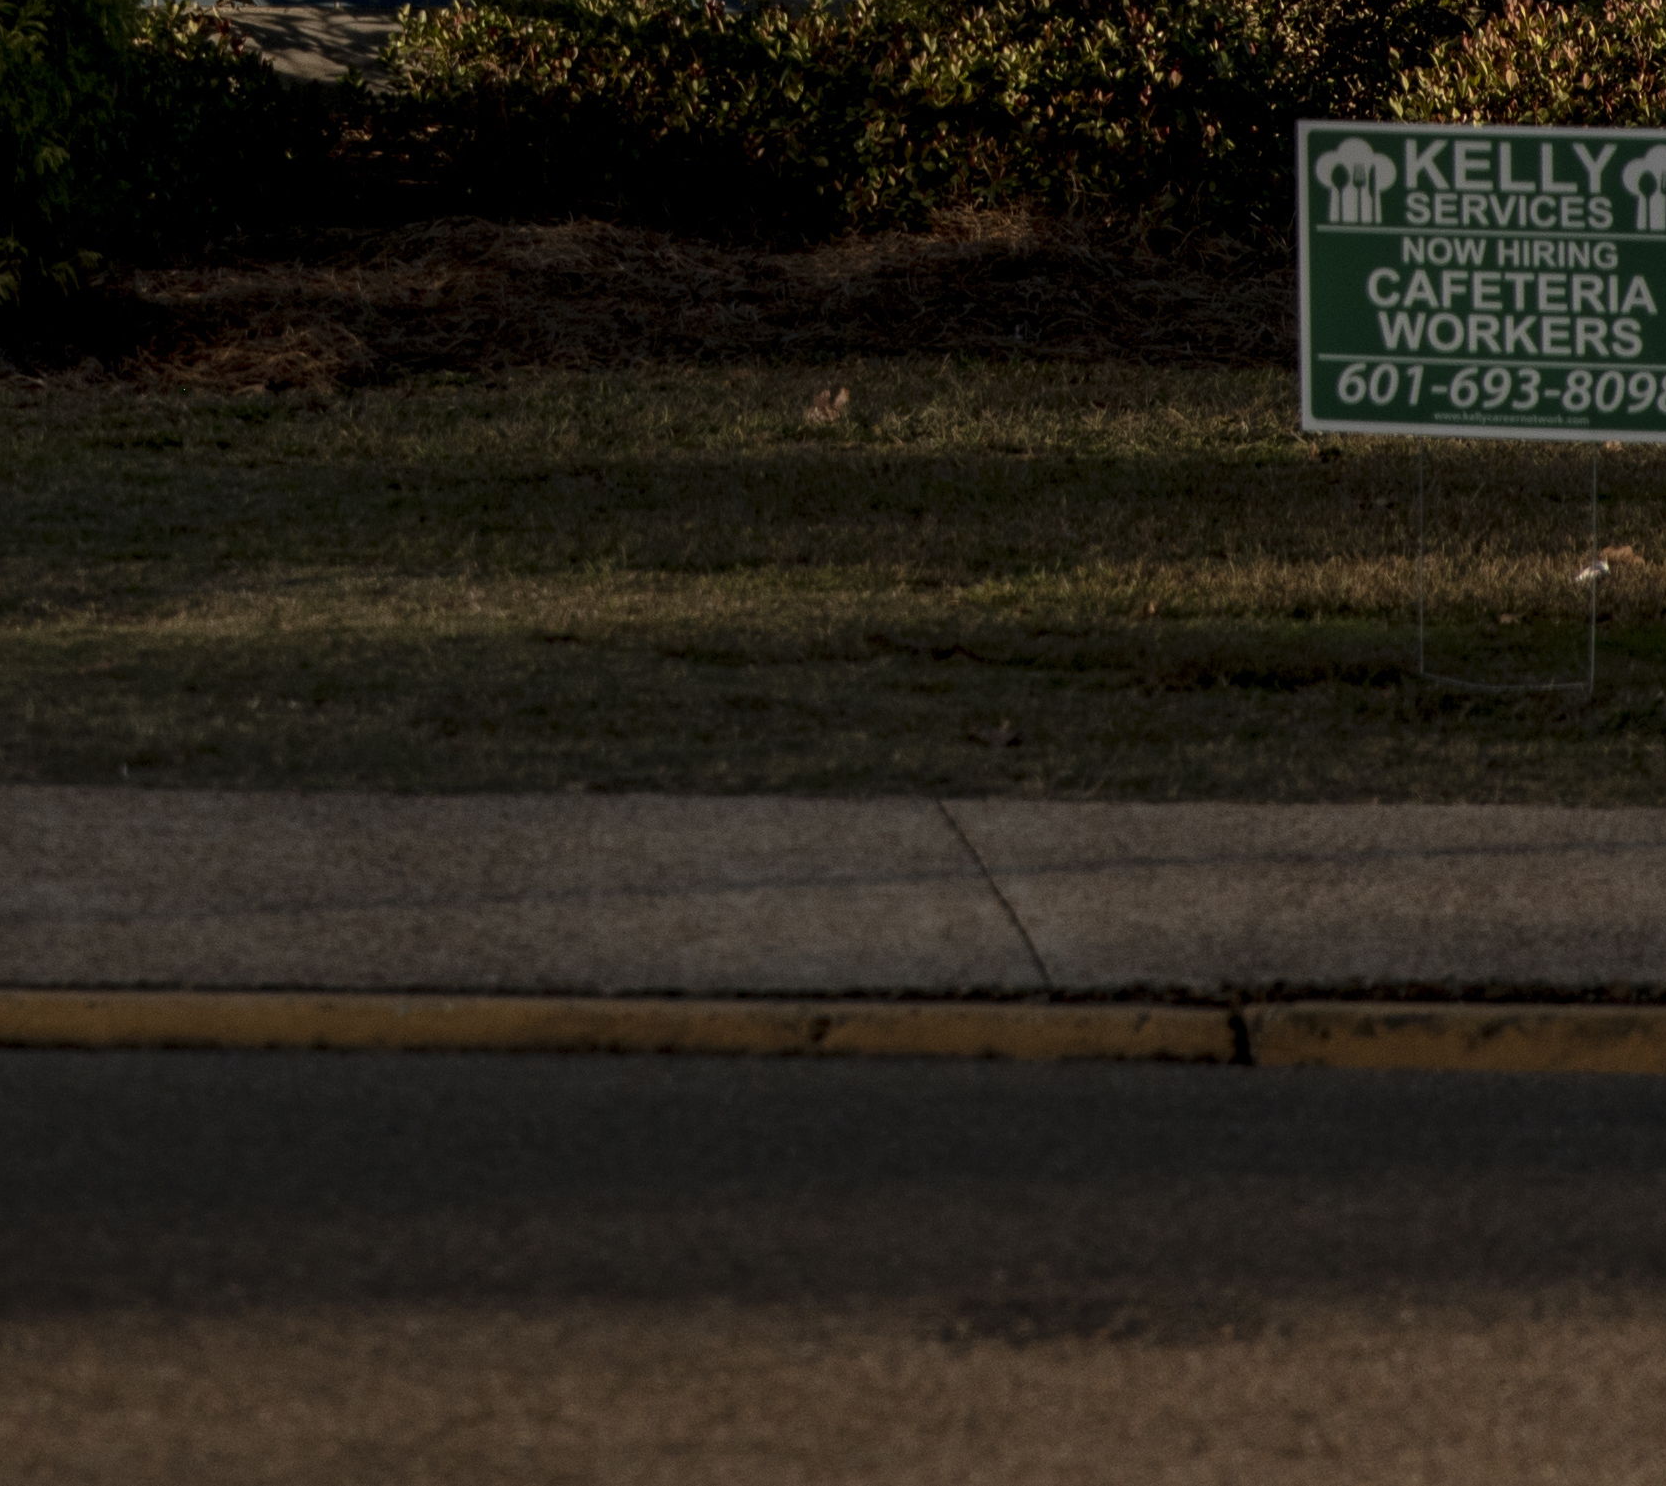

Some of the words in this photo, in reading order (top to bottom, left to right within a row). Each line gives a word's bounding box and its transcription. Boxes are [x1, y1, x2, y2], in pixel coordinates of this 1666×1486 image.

[1404, 139, 1618, 195] KELLY
[1405, 192, 1614, 229] SERVICES
[1402, 236, 1486, 266] NOW
[1496, 238, 1619, 269] HIRING
[1367, 267, 1658, 315] CAFETERIA
[1378, 311, 1644, 359] WORKERS
